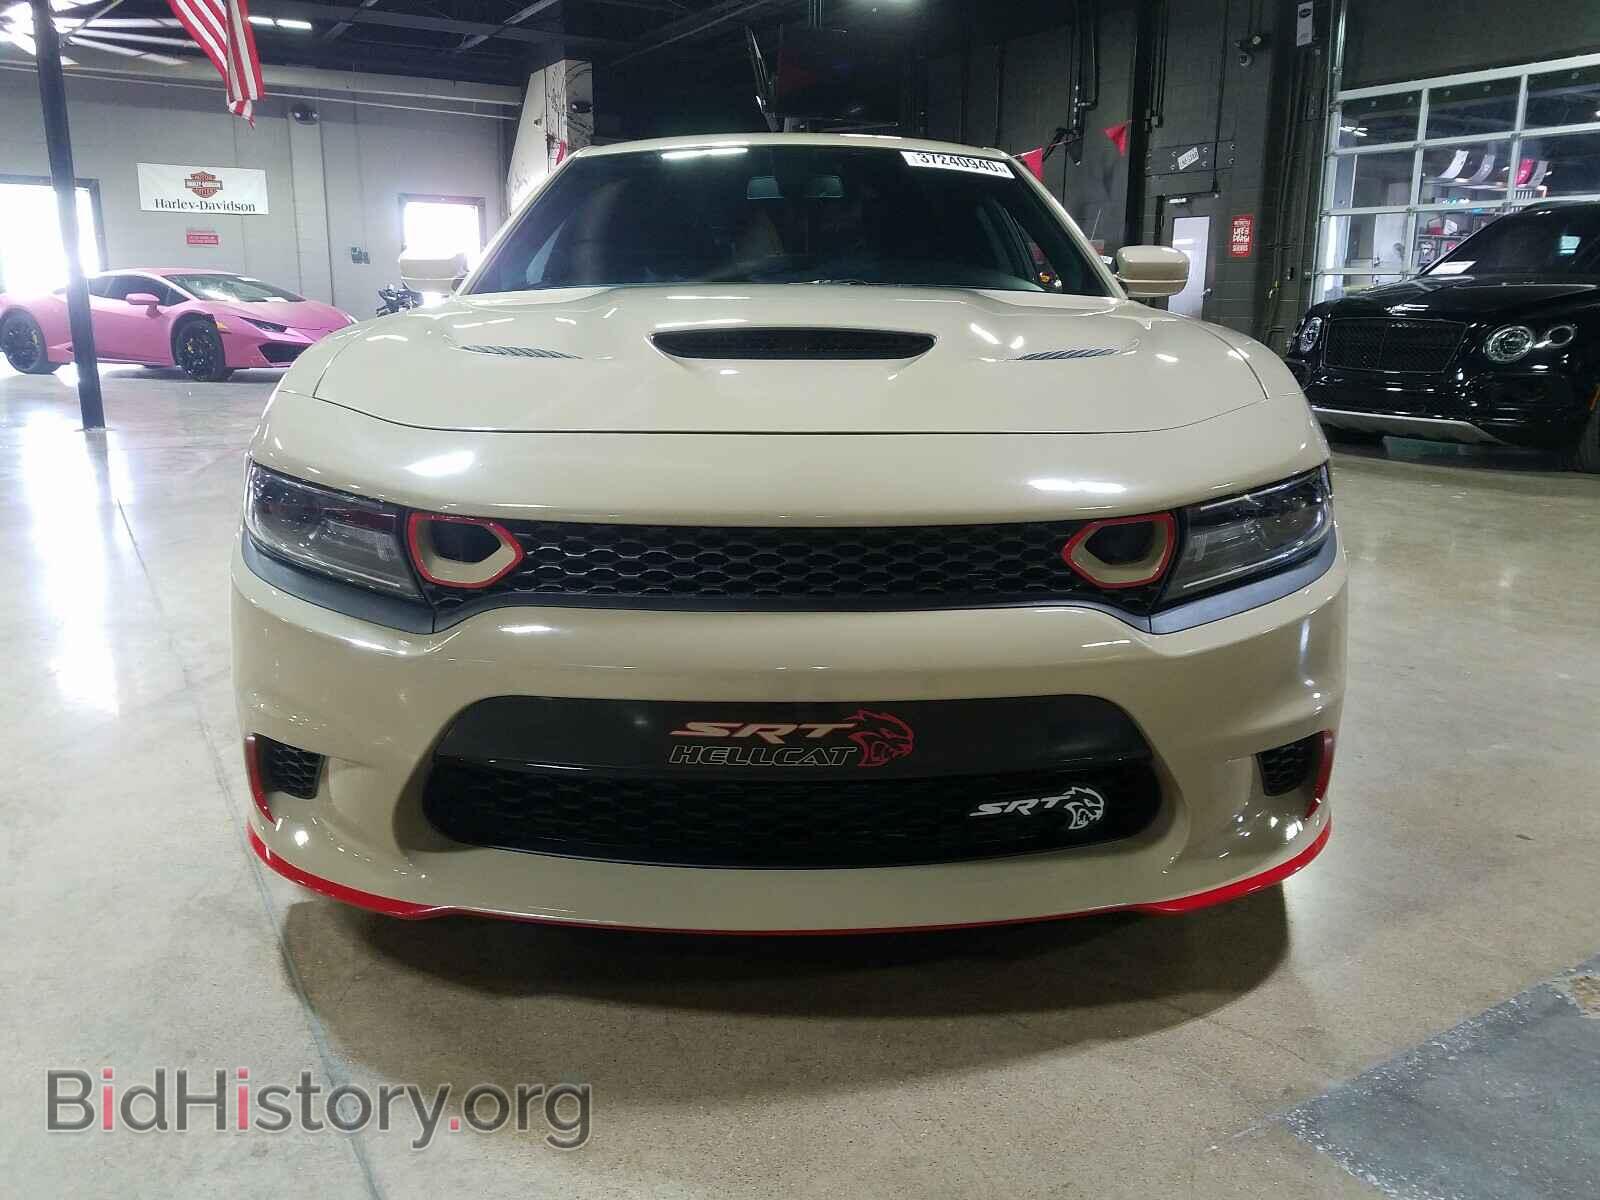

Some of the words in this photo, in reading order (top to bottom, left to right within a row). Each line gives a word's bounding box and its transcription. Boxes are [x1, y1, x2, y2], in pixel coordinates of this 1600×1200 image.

[917, 152, 998, 172] 37240940
[154, 198, 256, 212] Harley-Davidson
[669, 722, 857, 744] SRT
[669, 744, 857, 767] HELLCAT
[969, 795, 1071, 816] SRT
